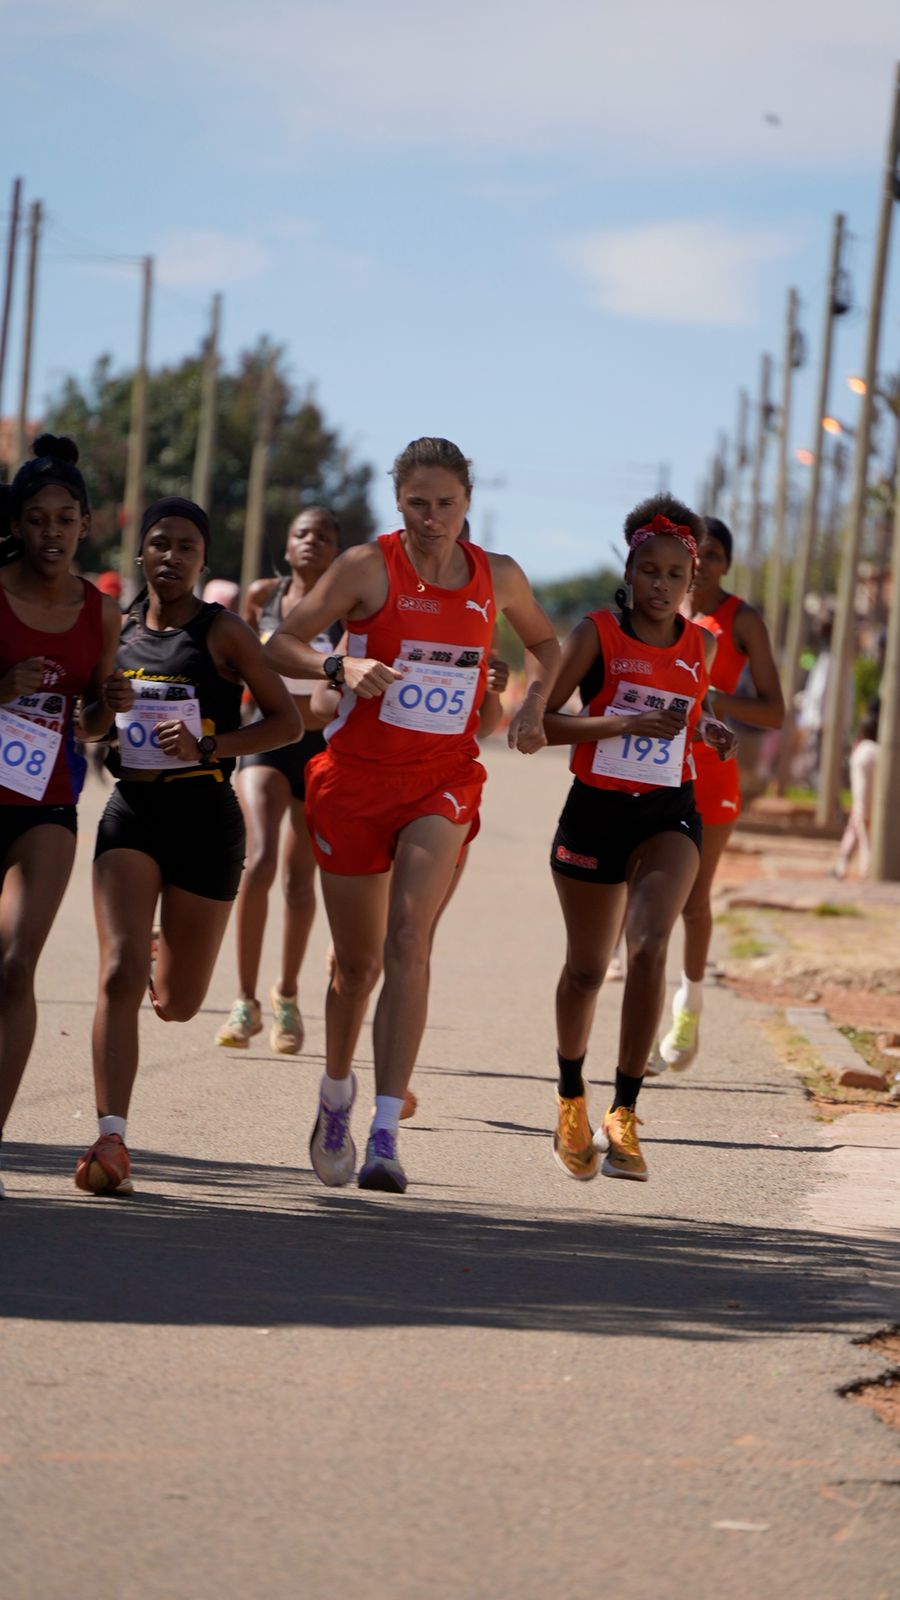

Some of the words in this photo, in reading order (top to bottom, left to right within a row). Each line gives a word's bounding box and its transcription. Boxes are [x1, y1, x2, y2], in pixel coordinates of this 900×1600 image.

[428, 651, 453, 662] 2026
[399, 685, 465, 715] 005
[644, 695, 665, 709] 2026
[0, 734, 46, 776] 08
[622, 735, 672, 765] 193
